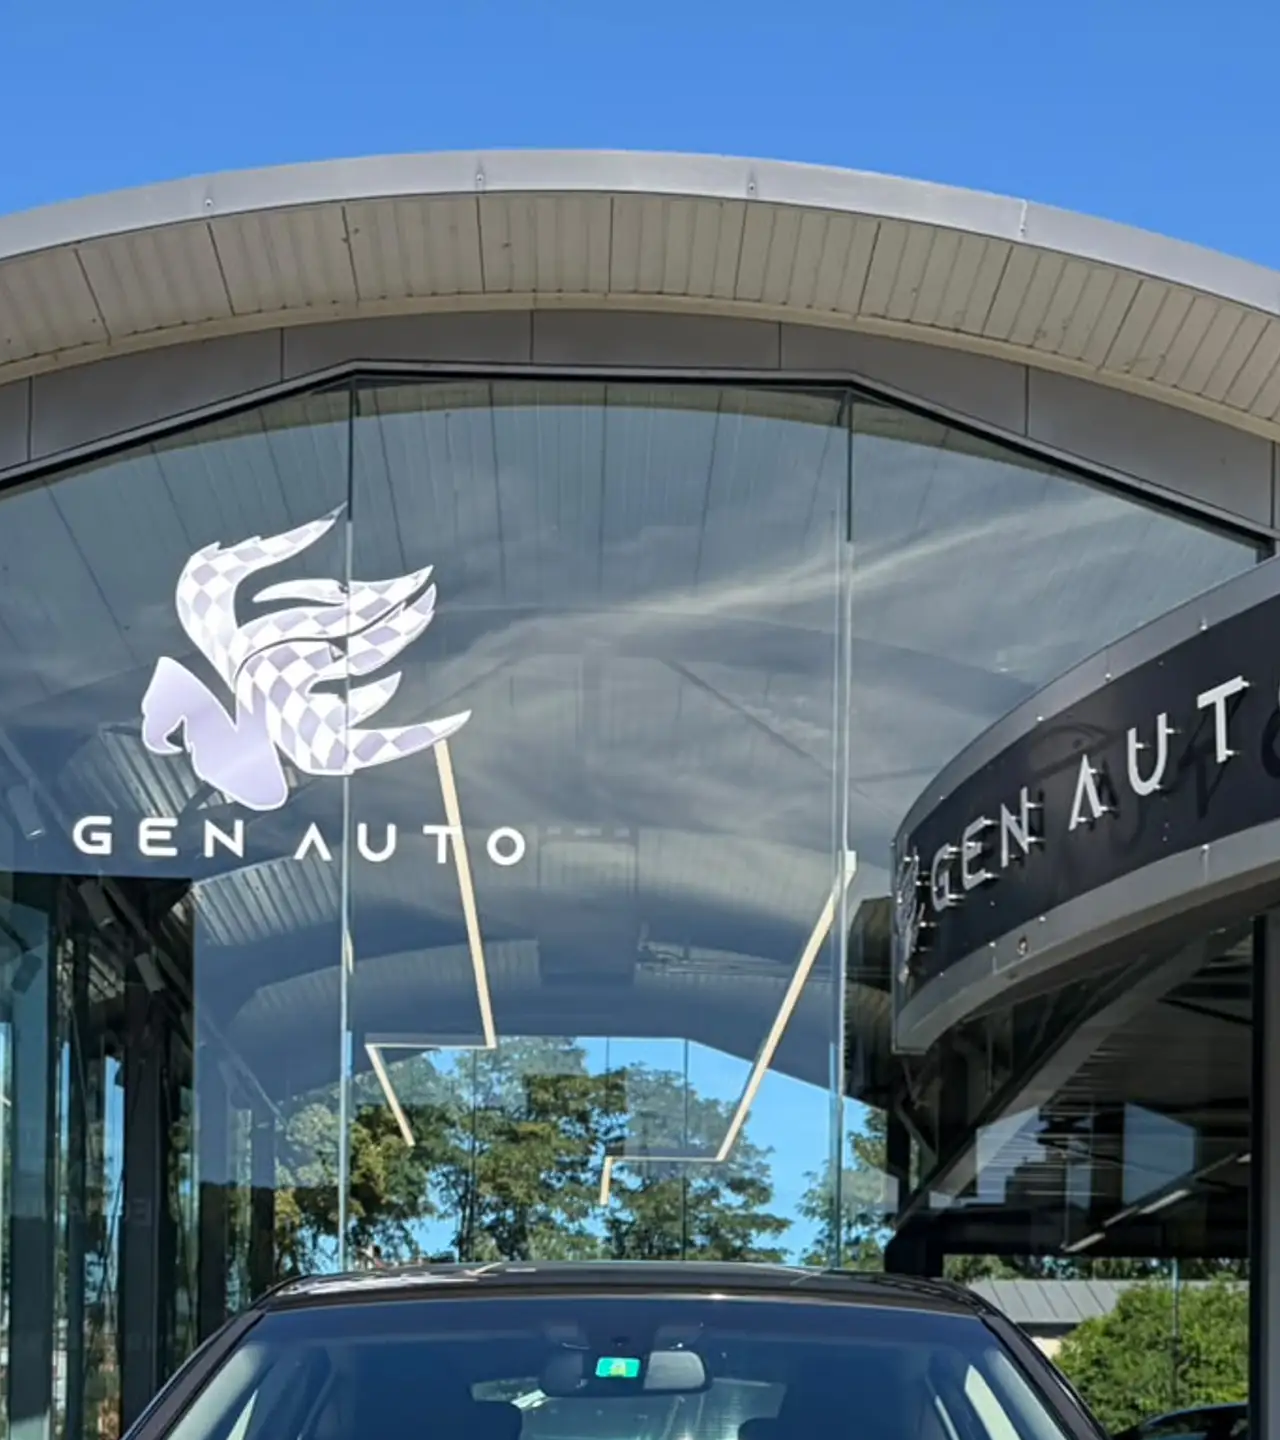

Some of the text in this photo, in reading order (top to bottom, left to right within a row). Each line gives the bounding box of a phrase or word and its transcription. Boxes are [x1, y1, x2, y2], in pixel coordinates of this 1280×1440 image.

[73, 815, 525, 866] GEN AUTO
[931, 787, 1038, 912] GEN
